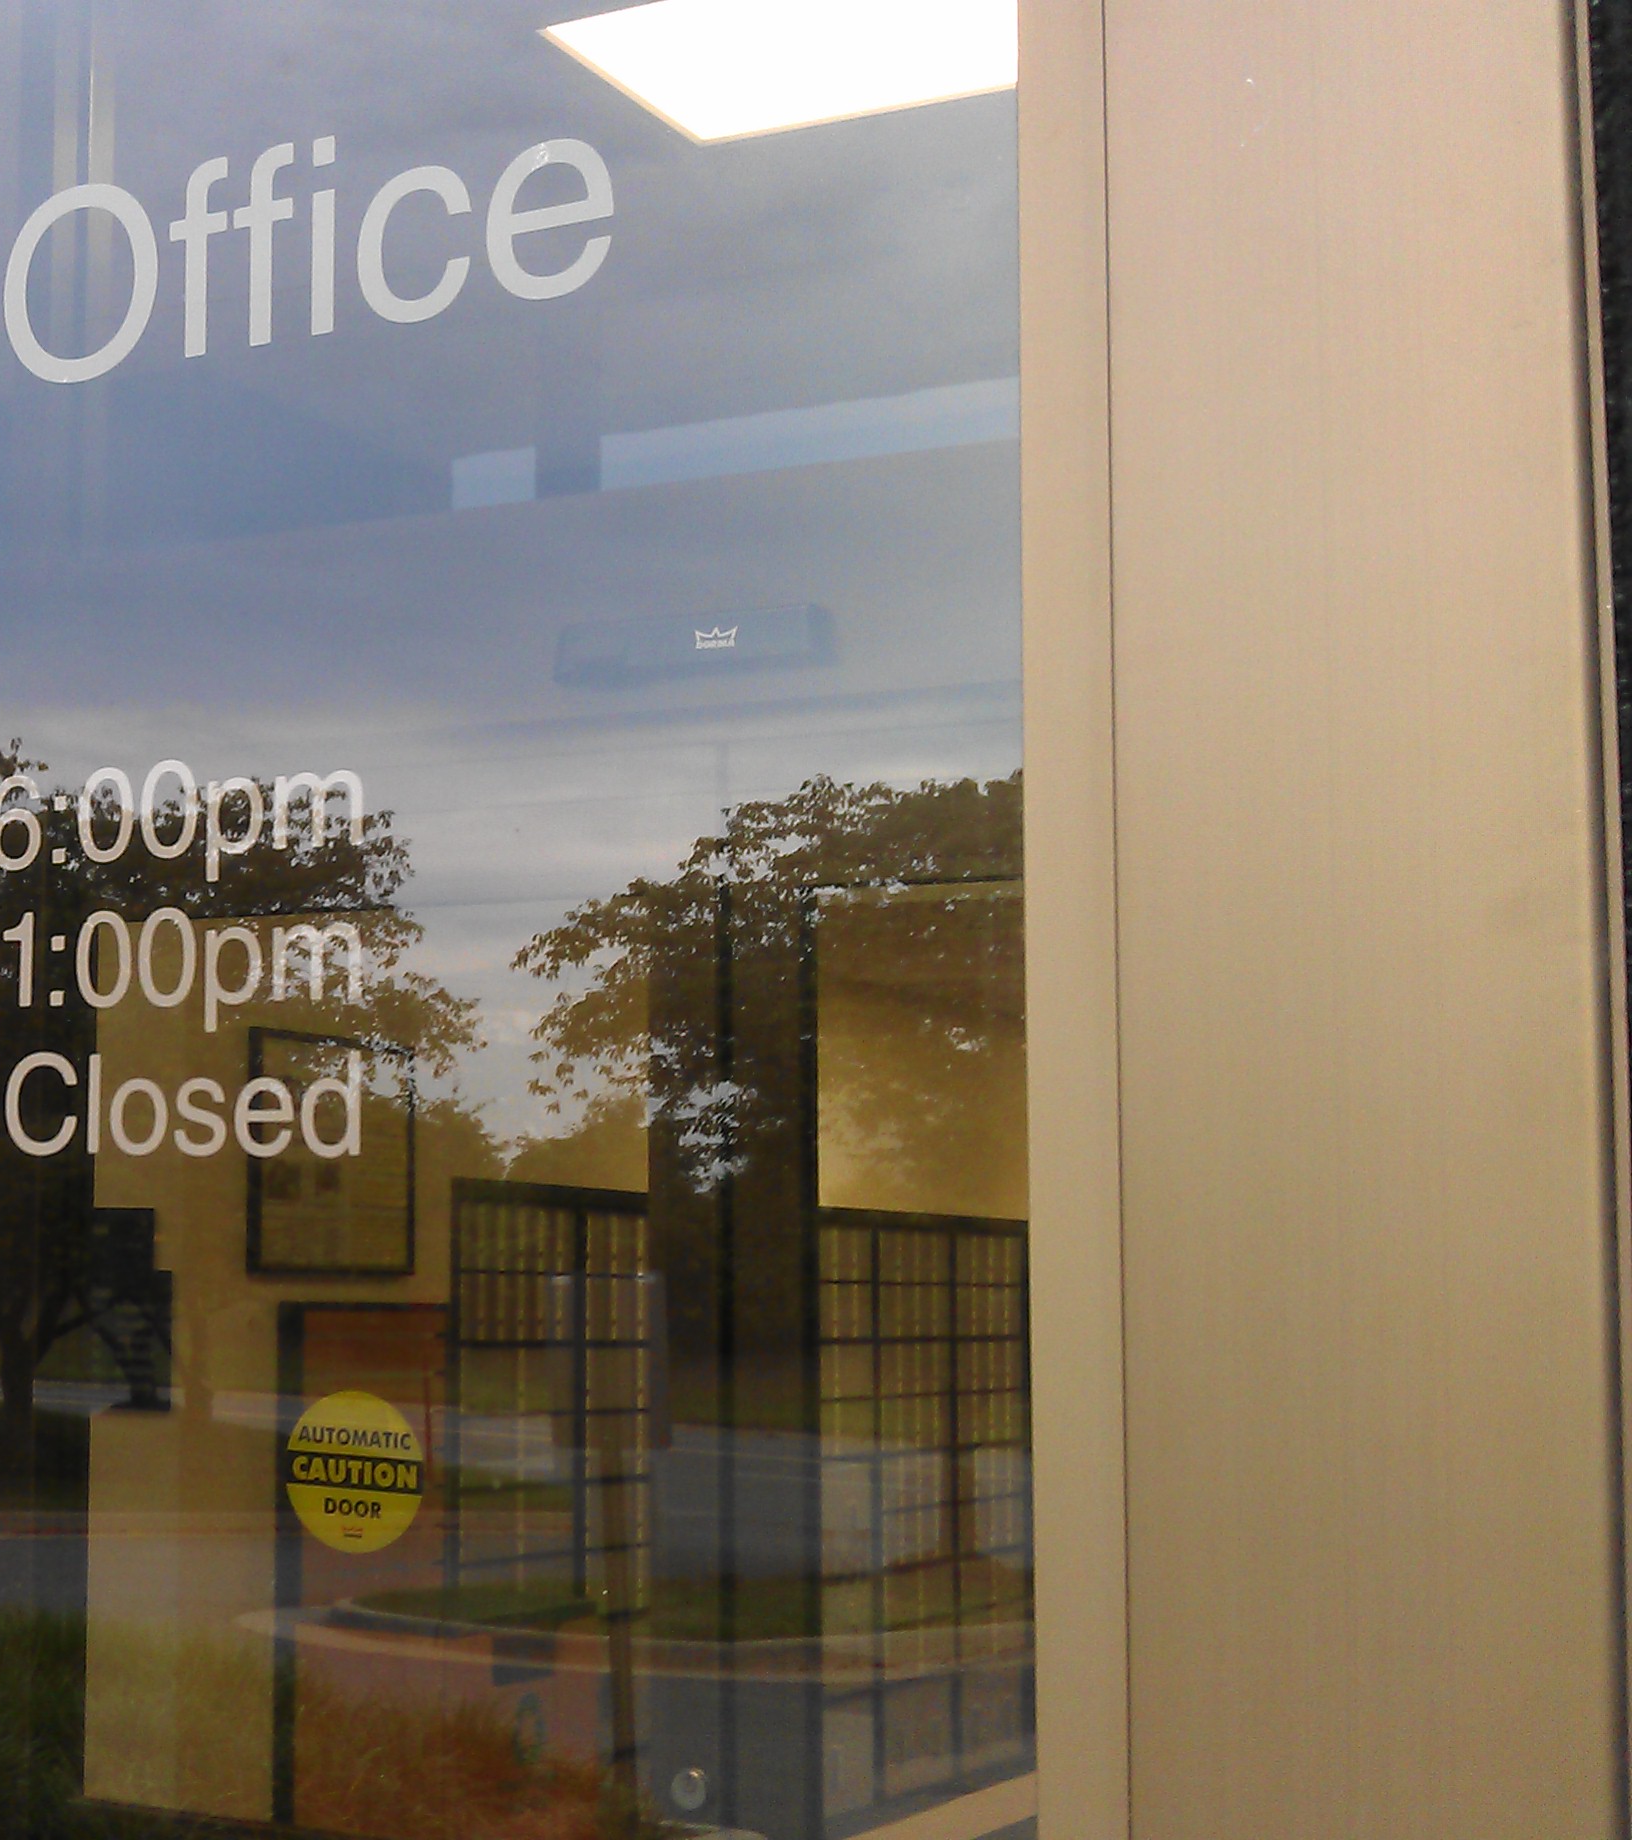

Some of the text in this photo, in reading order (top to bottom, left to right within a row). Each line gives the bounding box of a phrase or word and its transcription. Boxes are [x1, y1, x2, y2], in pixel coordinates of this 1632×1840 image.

[3, 135, 614, 383] Office
[2, 907, 363, 1034] 1:00pm
[5, 1050, 362, 1158] Closed
[292, 1456, 417, 1489] CAUTION
[298, 1426, 411, 1450] AUTOMATIC
[324, 1498, 382, 1519] DOOR
